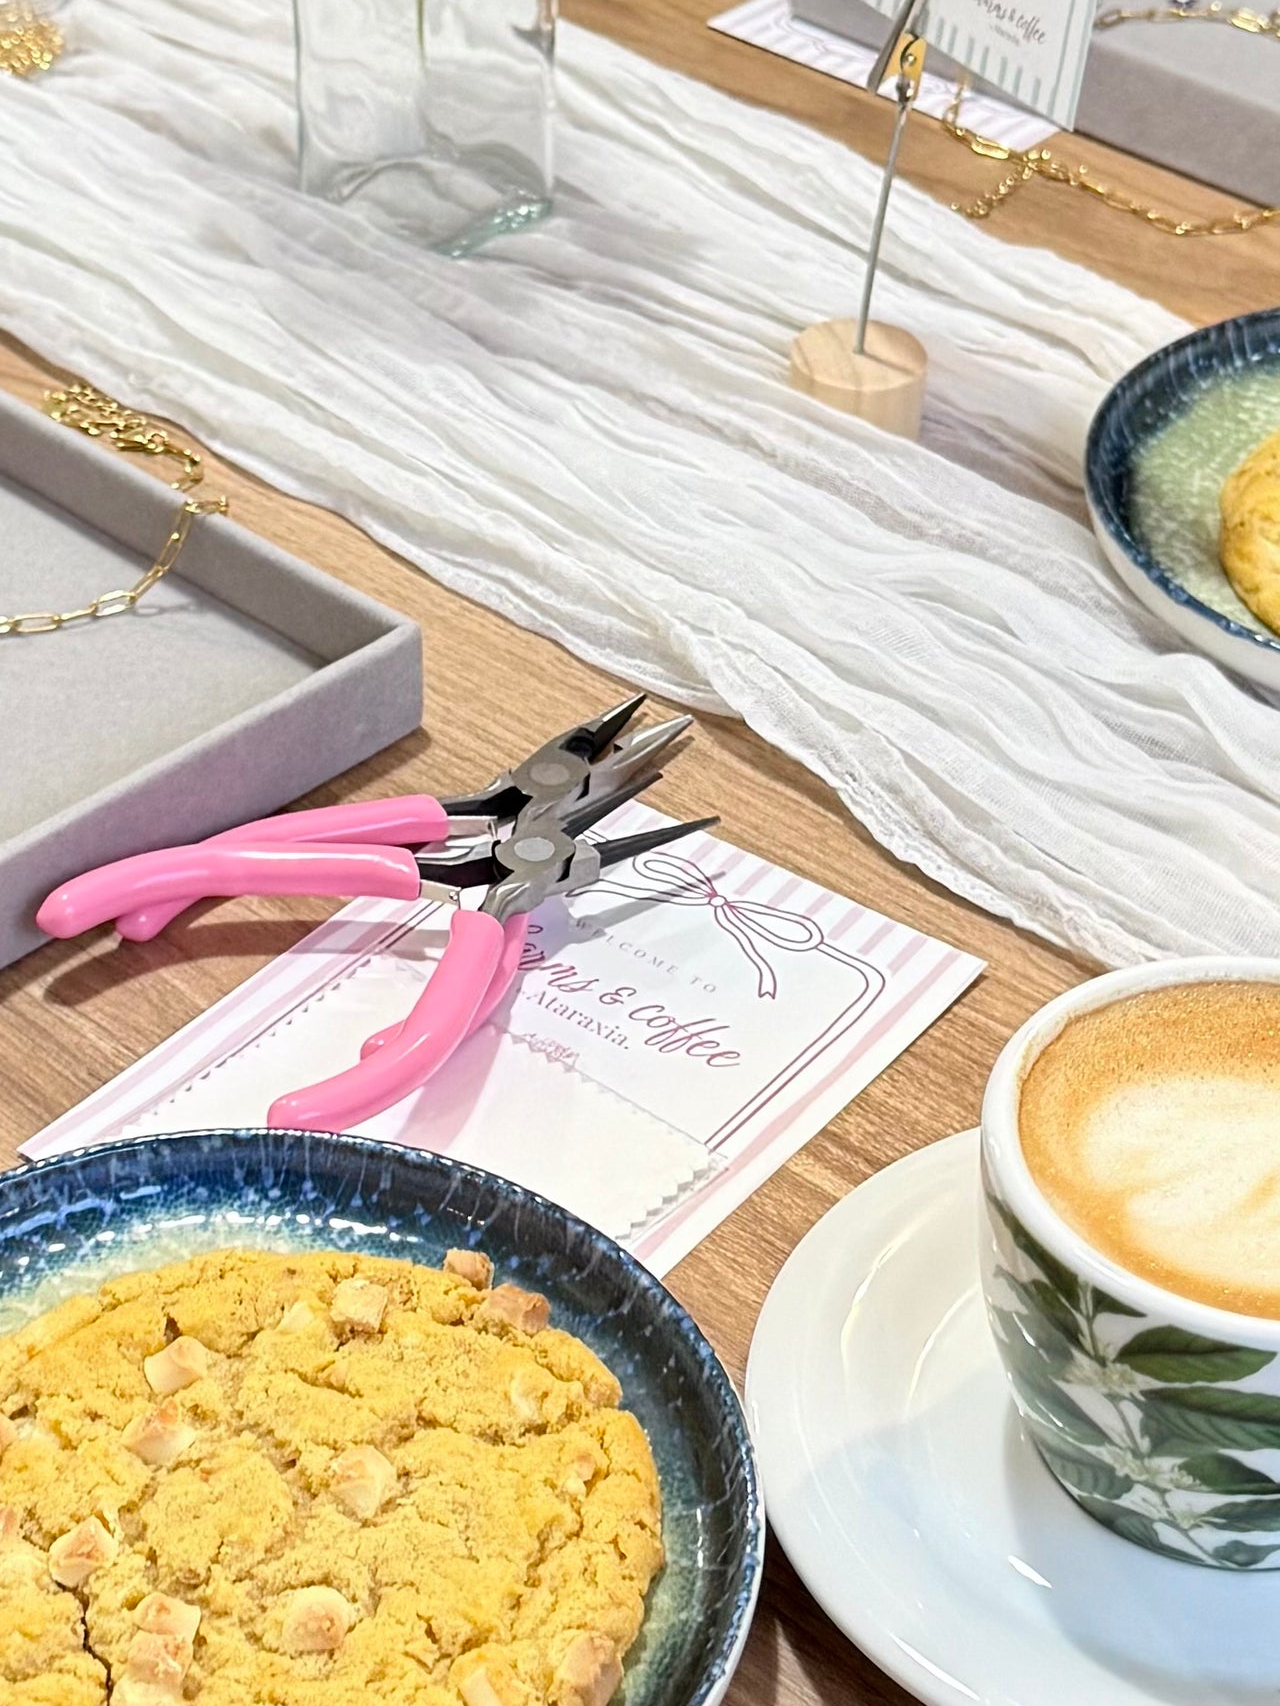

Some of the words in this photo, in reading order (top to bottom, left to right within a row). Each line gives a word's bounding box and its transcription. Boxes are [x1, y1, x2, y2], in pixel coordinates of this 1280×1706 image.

[1013, 14, 1046, 44] coffee
[575, 917, 680, 974] WELCOME
[689, 976, 718, 994] TO
[525, 990, 629, 1050] Ataraxia.
[599, 986, 637, 1005] &
[628, 1004, 741, 1068] coffee
